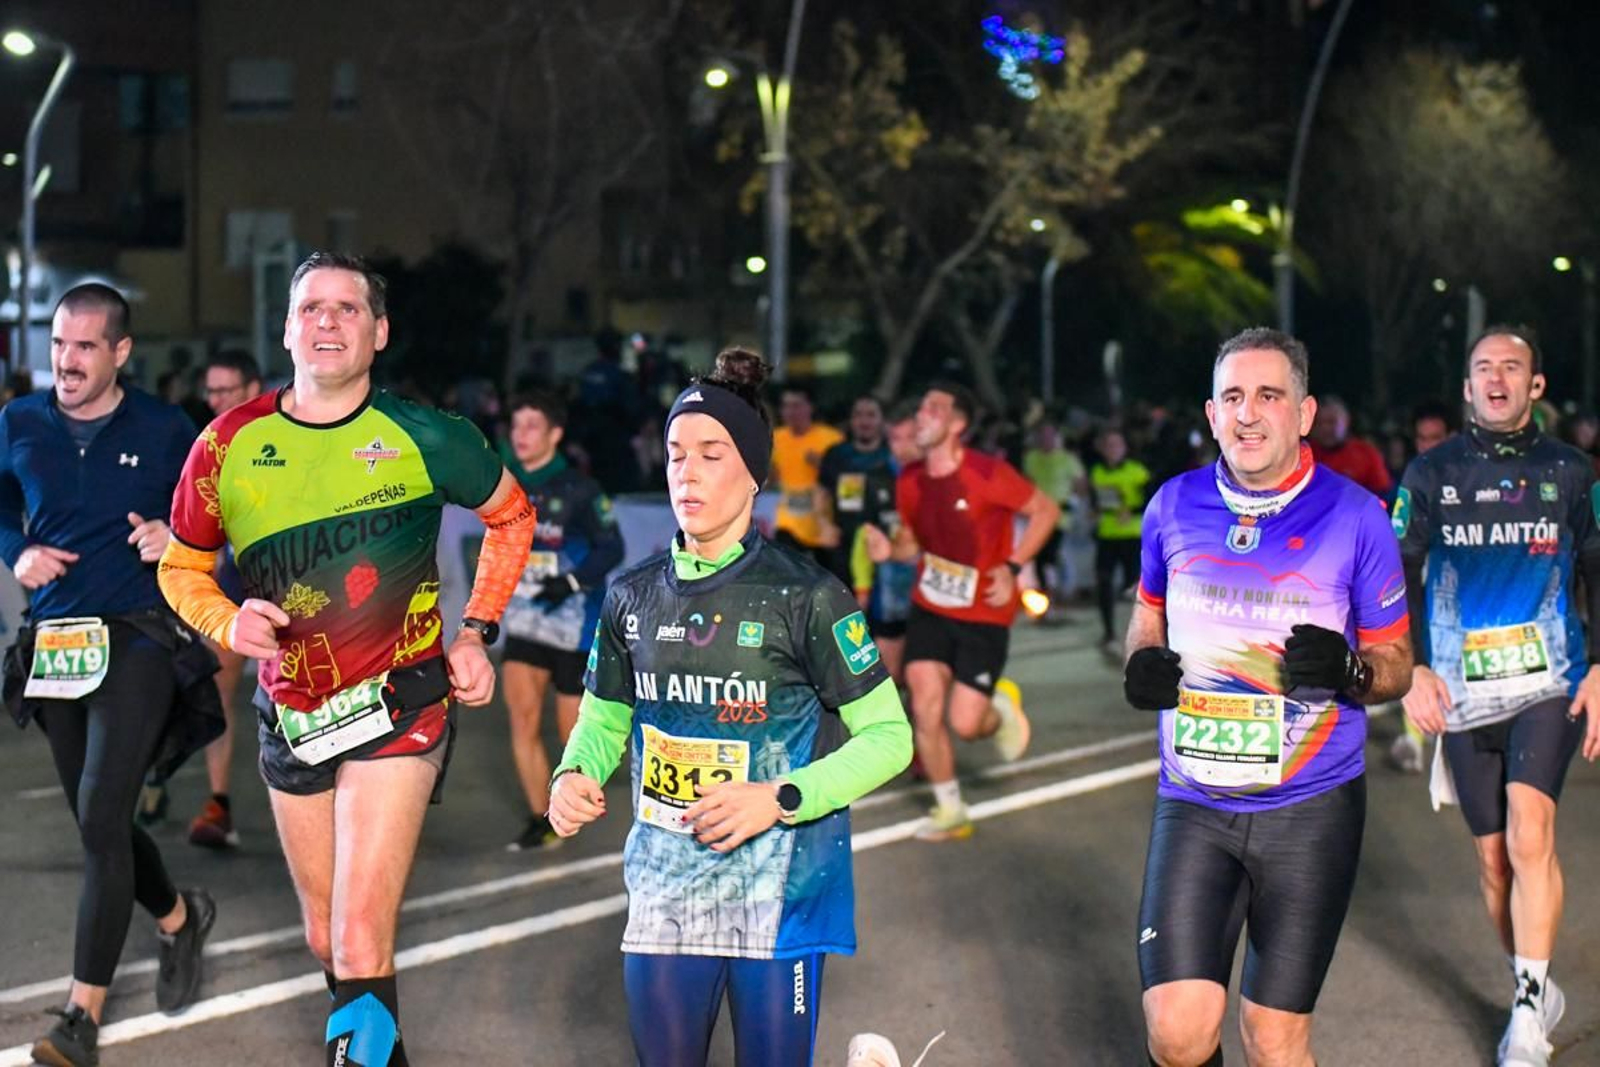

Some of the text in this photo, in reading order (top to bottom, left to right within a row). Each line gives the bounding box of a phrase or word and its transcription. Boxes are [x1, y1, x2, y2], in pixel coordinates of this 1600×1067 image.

[252, 458, 287, 467] VIATOR
[334, 483, 407, 513] VALDEPEÑAS
[1442, 516, 1558, 546] SAN ANTÓN
[655, 621, 685, 641] jaén
[40, 648, 103, 674] 1479
[1468, 641, 1540, 676] 1328
[666, 671, 767, 707] ANTÓN
[288, 679, 373, 736] 1964
[716, 699, 768, 723] 2025
[1180, 714, 1271, 755] 2232
[793, 961, 805, 1014] joma
